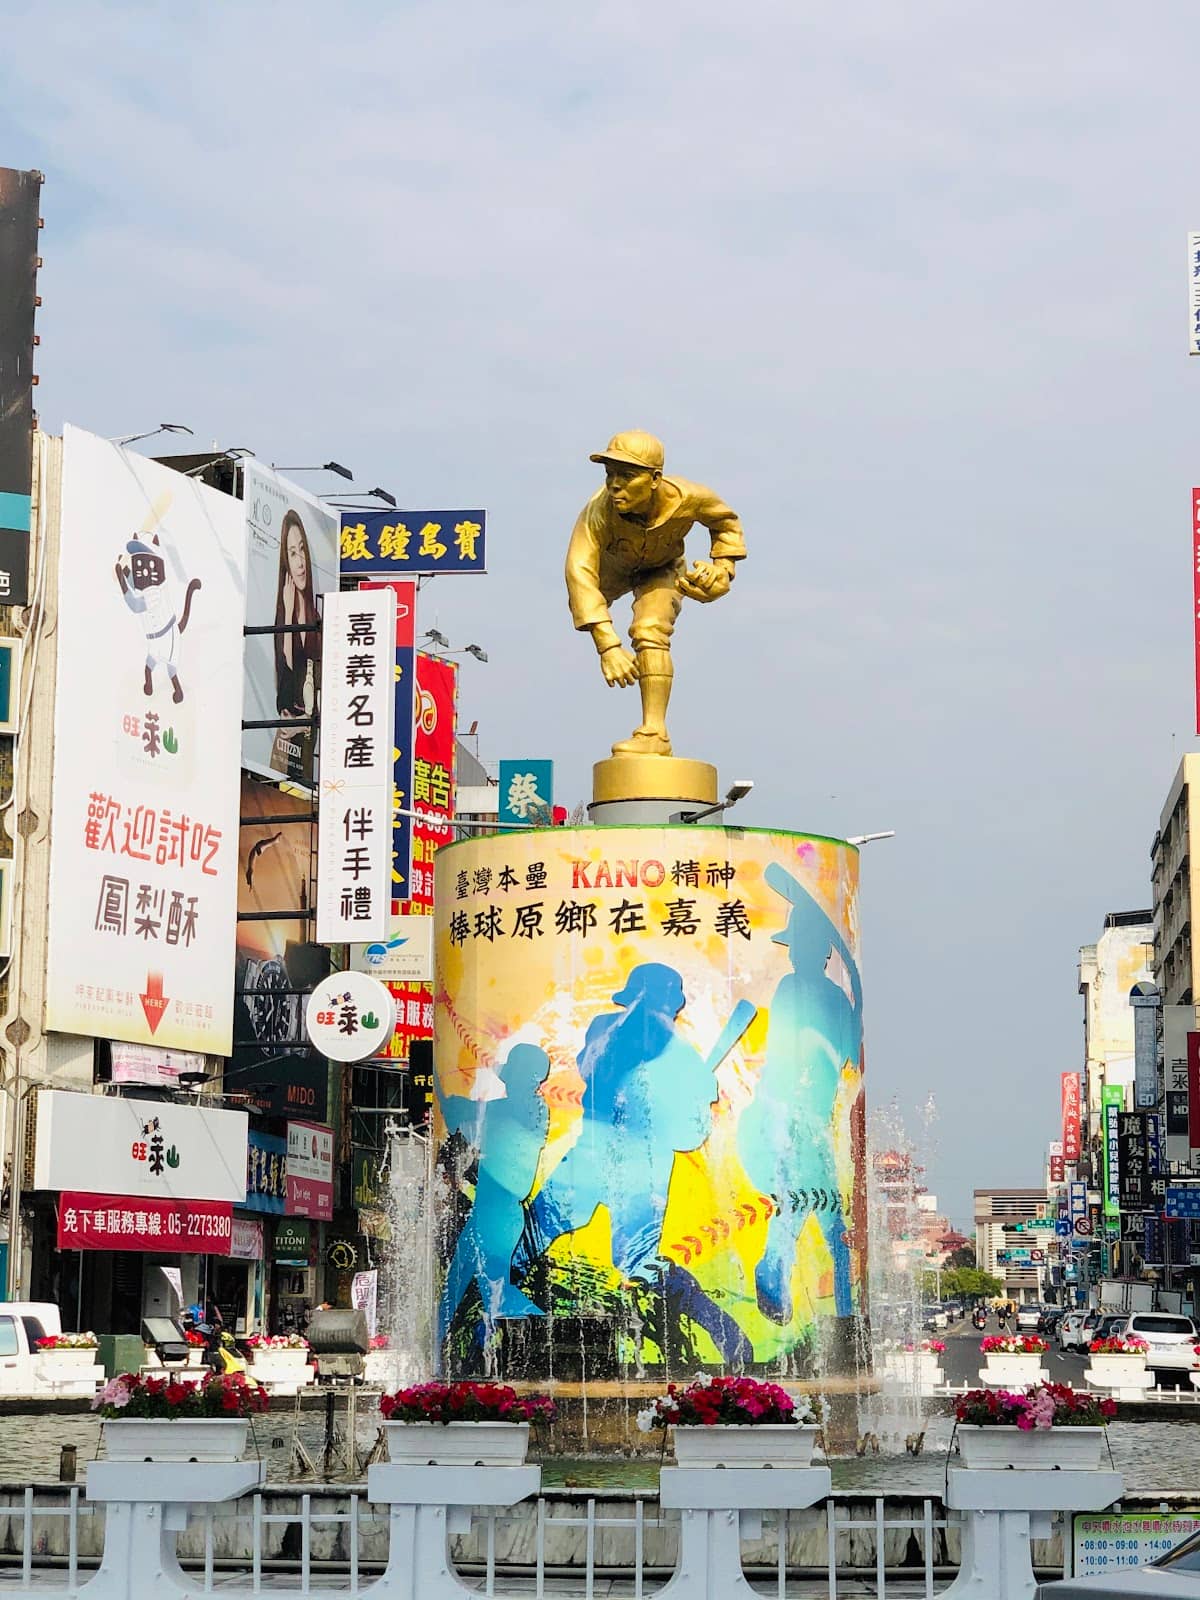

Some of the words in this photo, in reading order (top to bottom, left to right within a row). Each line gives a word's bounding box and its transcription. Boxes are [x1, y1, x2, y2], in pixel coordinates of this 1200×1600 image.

[344, 612, 377, 769] 嘉義名產
[414, 758, 451, 809] 廣告
[505, 773, 548, 818] 蔡
[85, 791, 224, 877] 歡迎試吃
[340, 807, 372, 922] 伴手禮
[456, 861, 548, 901] 臺灣本壘
[572, 859, 666, 889] KANO
[671, 859, 737, 889] 精神
[94, 874, 200, 948] 鳳梨酥
[449, 898, 753, 948] 棒球原鄉在嘉義
[144, 998, 164, 1009] HERE
[287, 1085, 315, 1106] MIDO
[274, 1236, 306, 1245] TITONI
